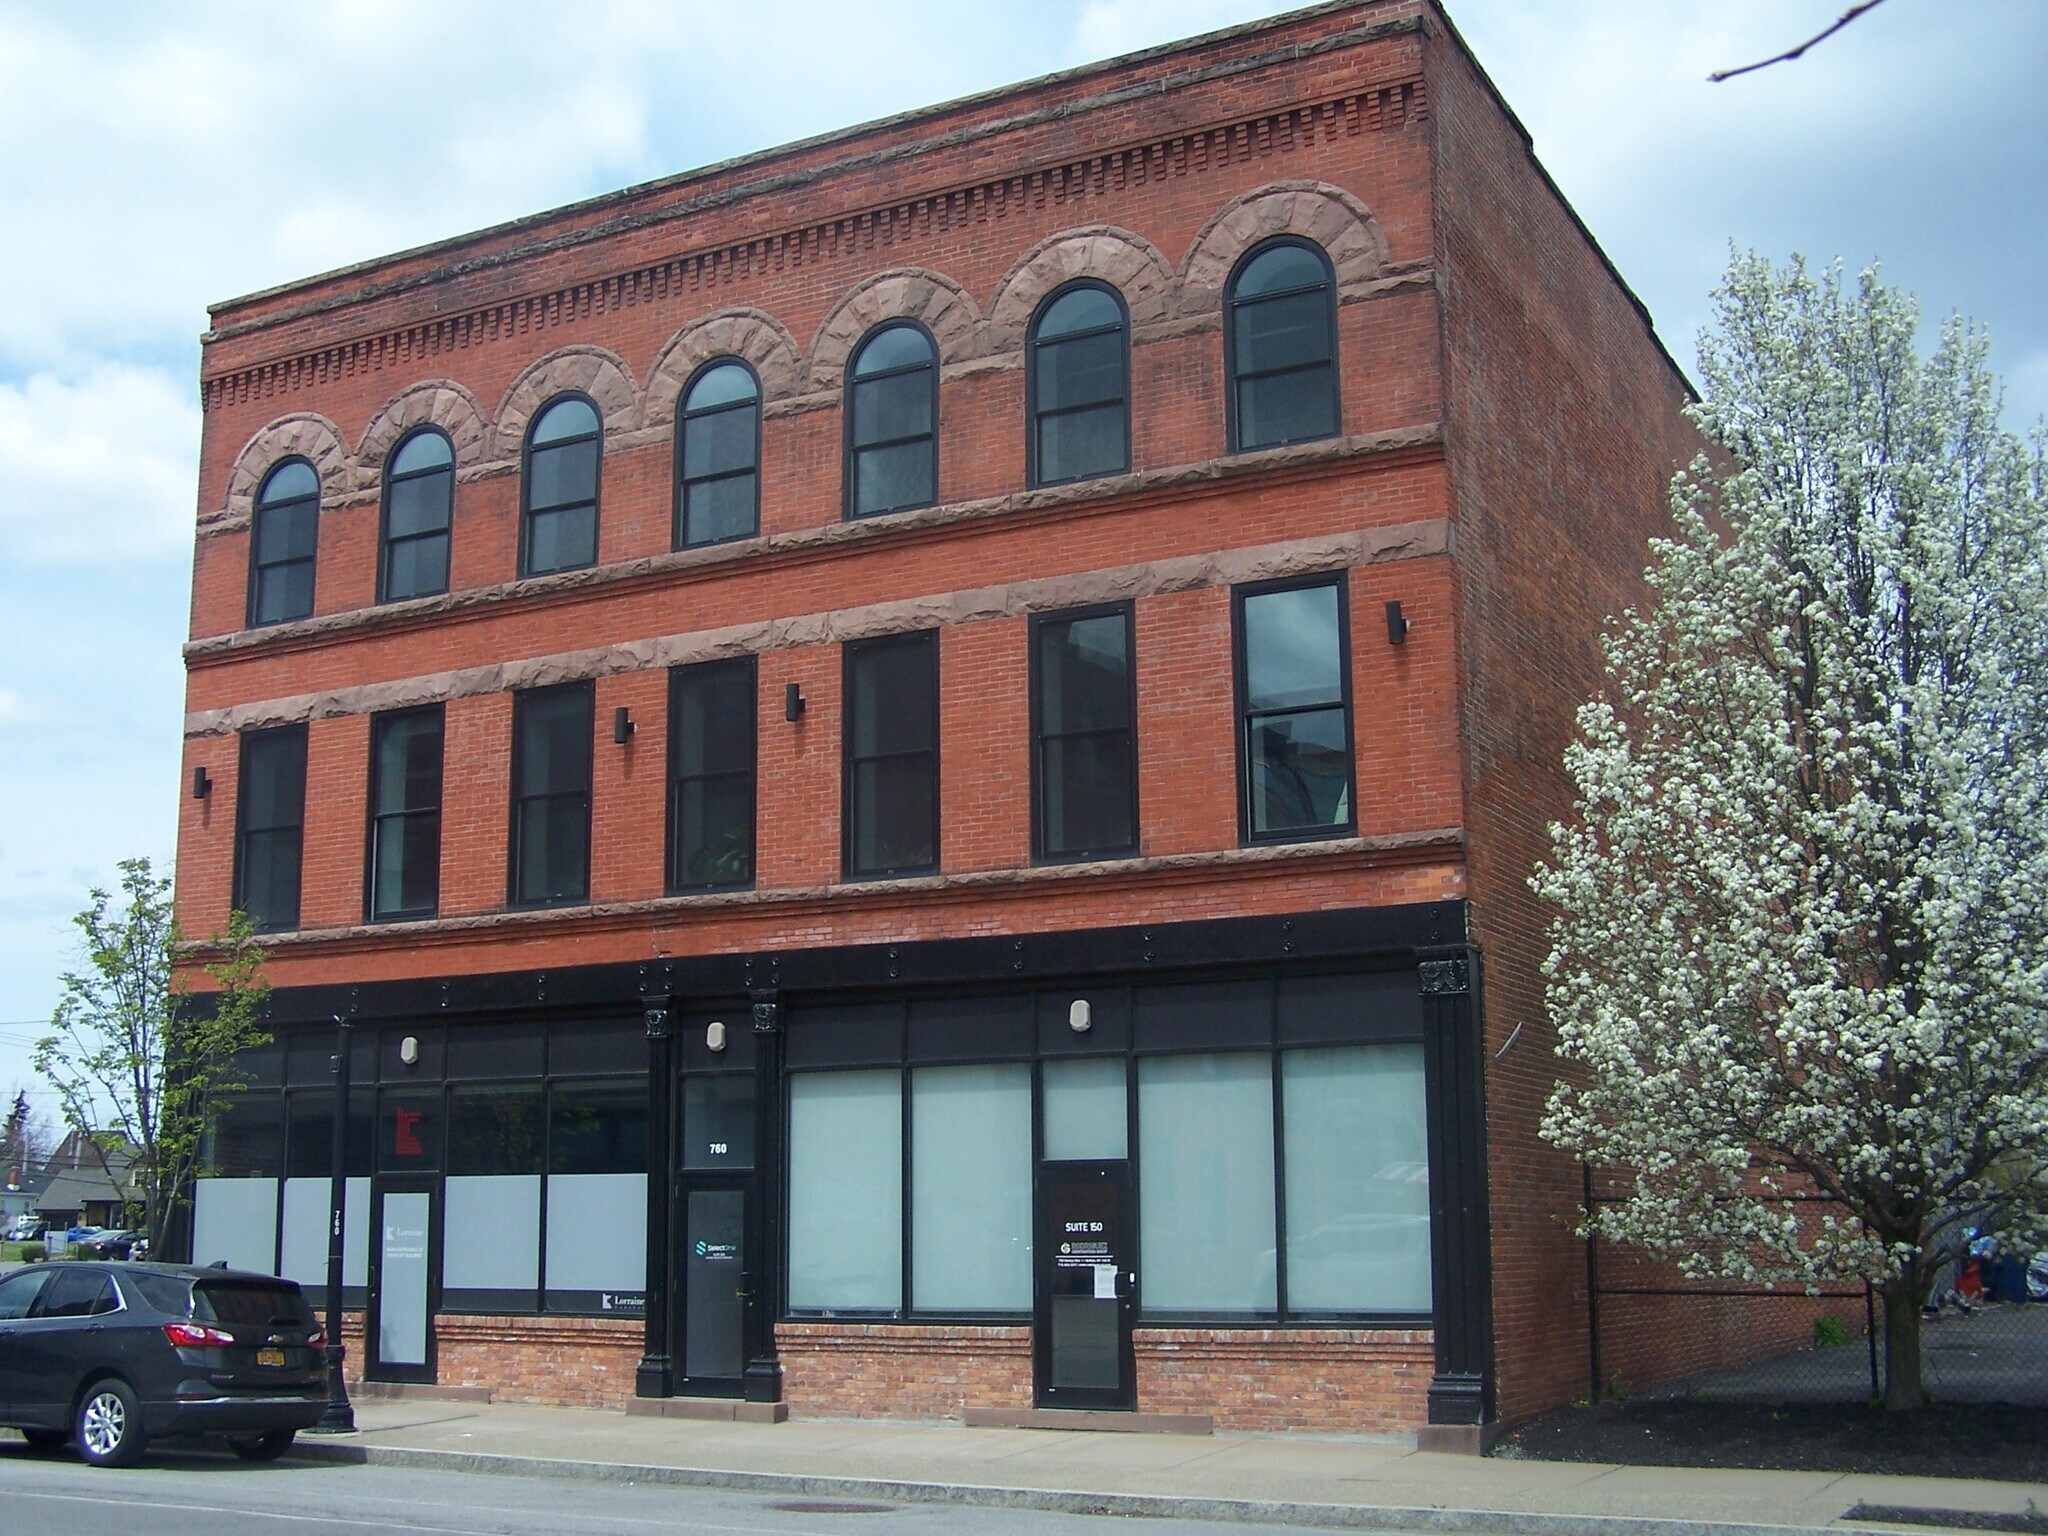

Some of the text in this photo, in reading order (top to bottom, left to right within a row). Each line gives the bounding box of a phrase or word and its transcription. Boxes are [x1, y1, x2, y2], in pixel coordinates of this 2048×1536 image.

[709, 1143, 728, 1154] 760
[1065, 1222, 1103, 1232] SUITE 150
[614, 1295, 646, 1305] Lorraine
